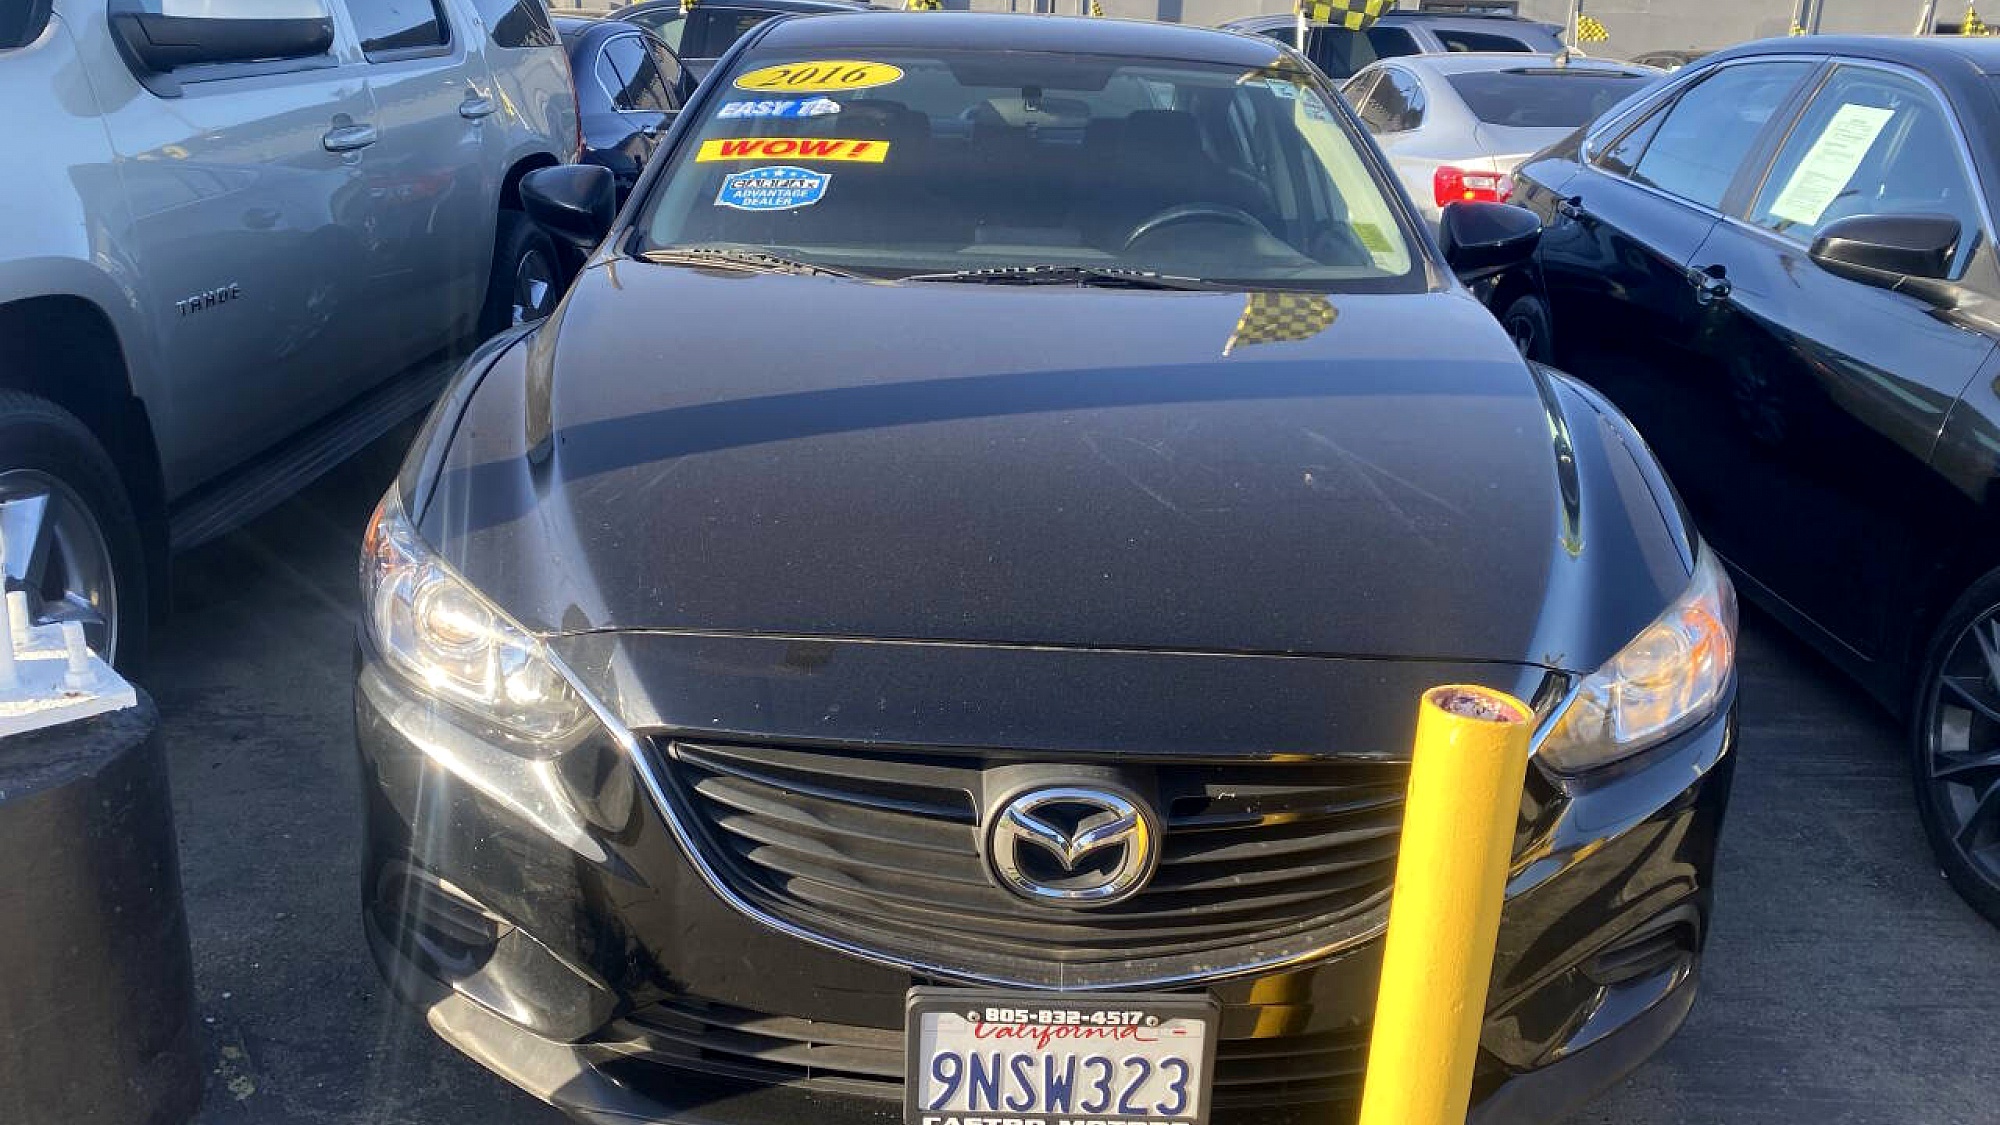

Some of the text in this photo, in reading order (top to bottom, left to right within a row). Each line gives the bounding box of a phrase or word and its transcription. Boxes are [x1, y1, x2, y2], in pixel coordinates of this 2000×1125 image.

[757, 65, 874, 87] 2016
[717, 101, 796, 118] EASY
[733, 189, 809, 198] ADVANTAGE
[742, 198, 793, 206] DEALER
[176, 283, 240, 315] TAHOE
[985, 1007, 1143, 1026] 805-832-4517
[974, 1021, 1158, 1050] California
[929, 1051, 1190, 1116] 9NSW323
